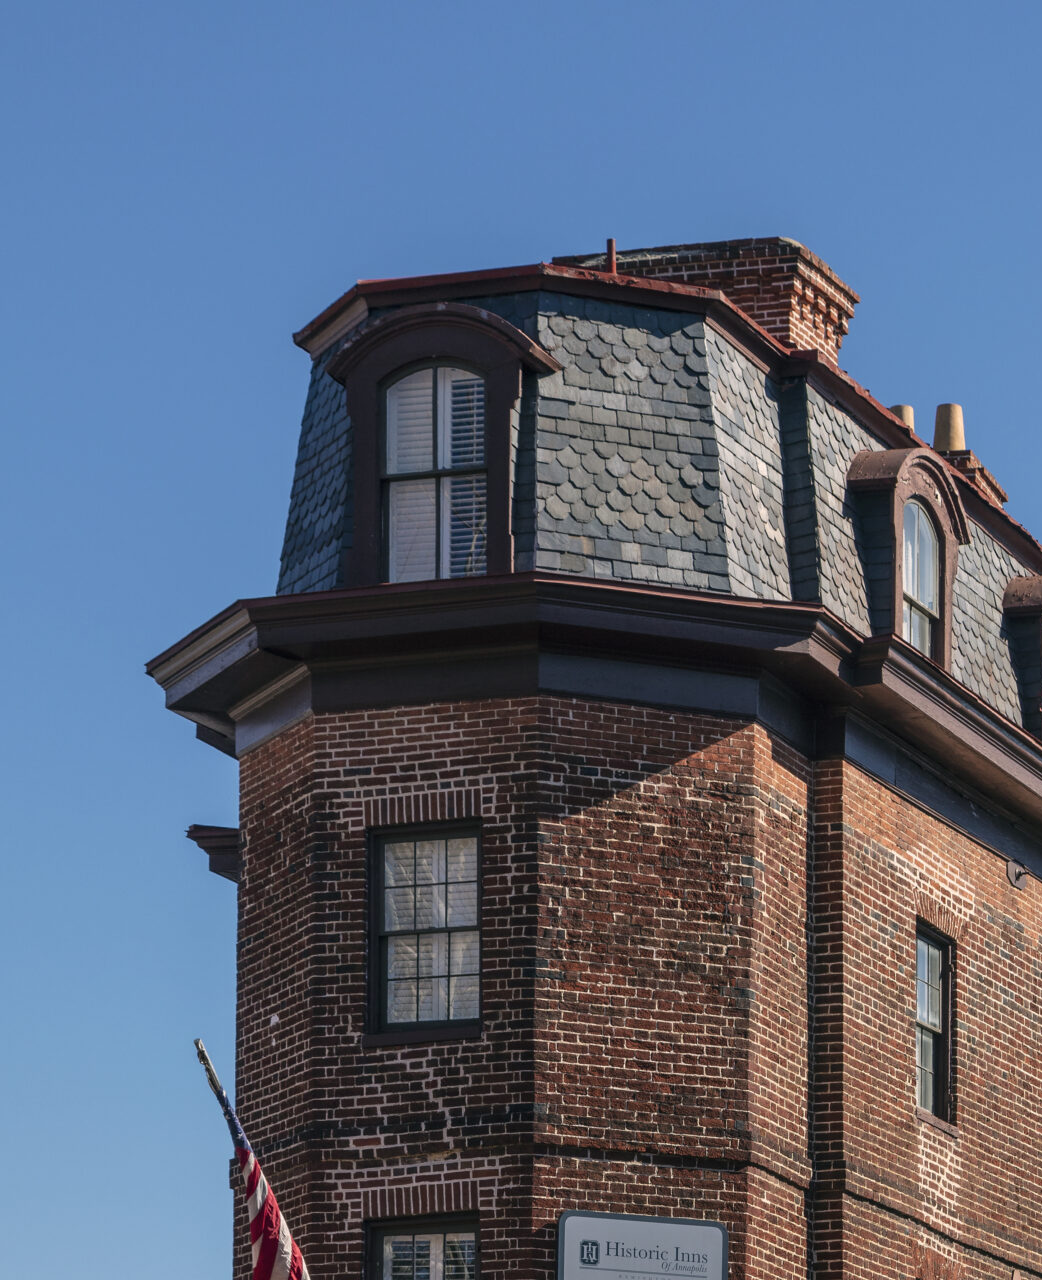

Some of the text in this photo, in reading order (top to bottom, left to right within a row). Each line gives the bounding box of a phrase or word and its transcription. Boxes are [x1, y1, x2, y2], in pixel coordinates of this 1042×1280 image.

[605, 1241, 709, 1264] Historic Inns
[661, 1261, 708, 1274] Of Annapolis
